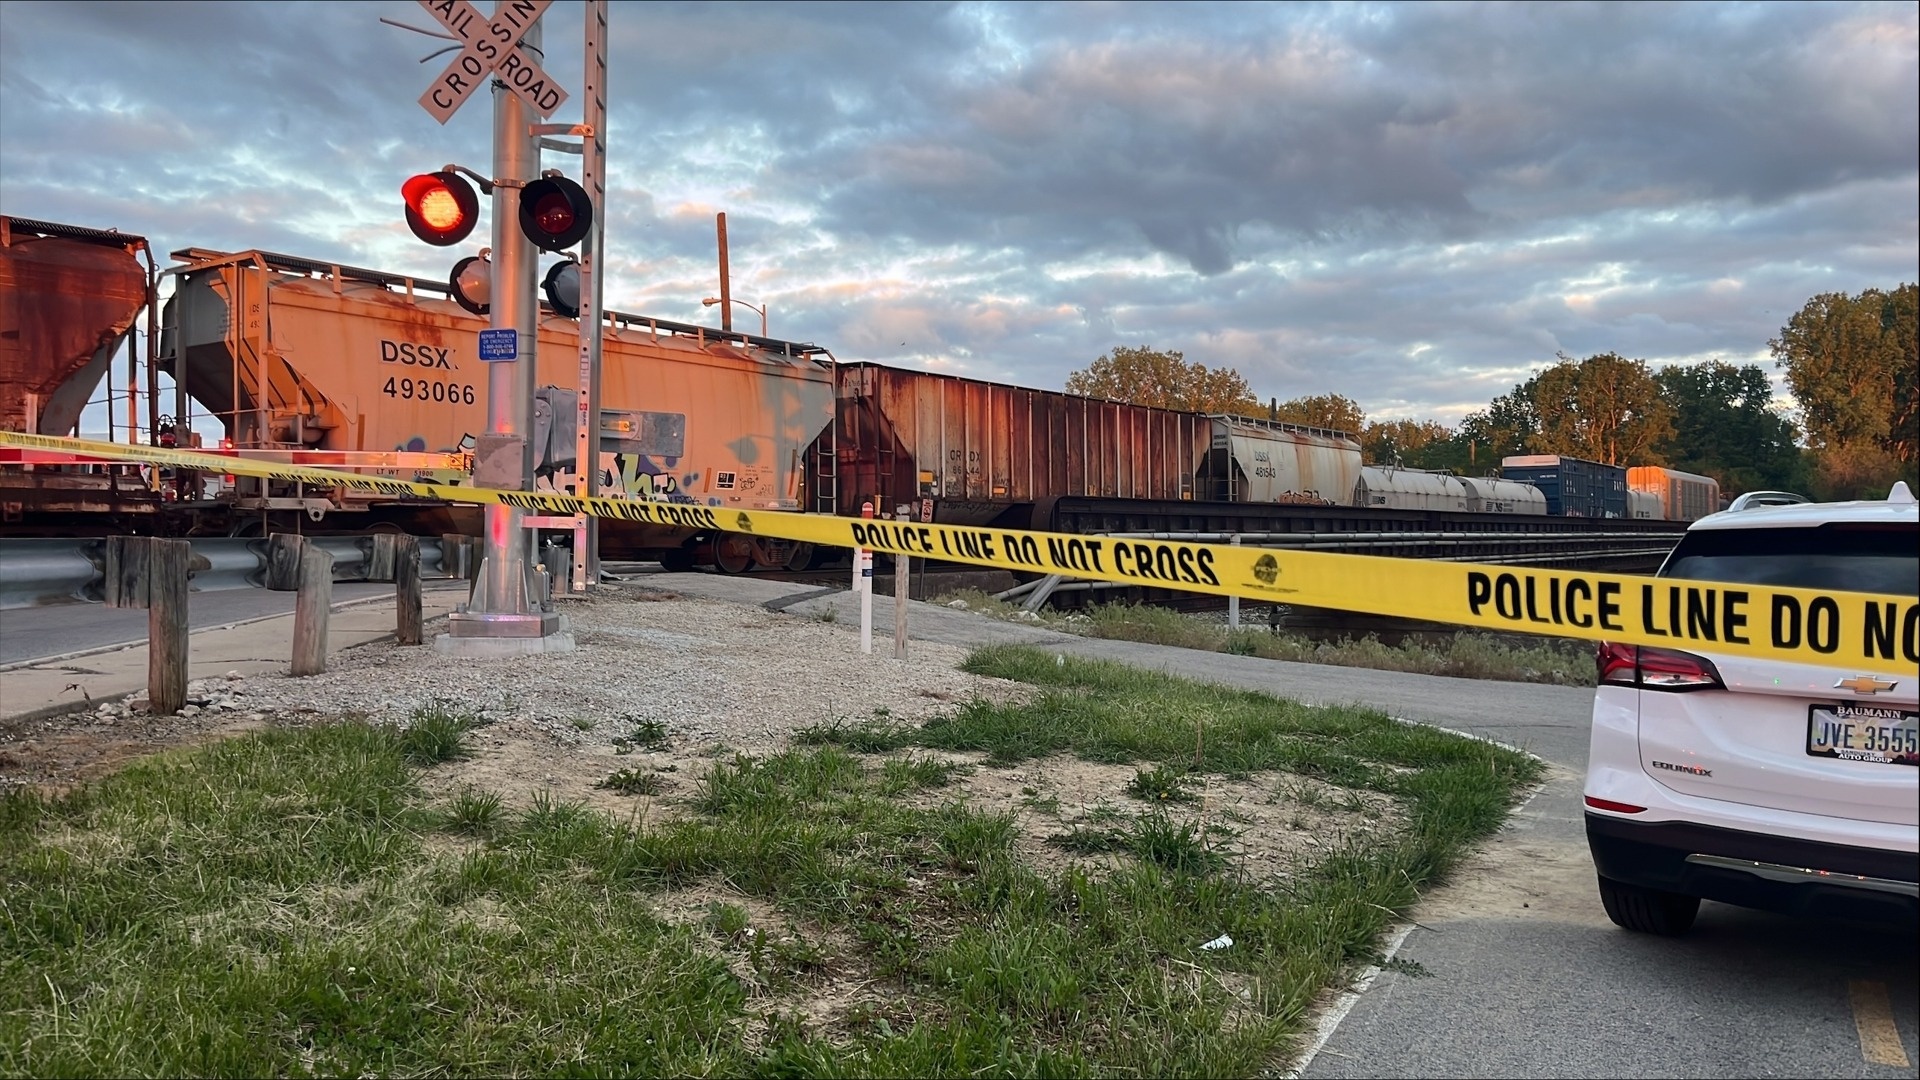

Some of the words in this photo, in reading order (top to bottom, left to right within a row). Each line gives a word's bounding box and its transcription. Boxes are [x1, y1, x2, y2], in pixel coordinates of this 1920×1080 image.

[429, 0, 474, 39] AIL
[500, 53, 560, 110] ROAD
[432, 0, 536, 109] CROSSIN
[381, 340, 451, 370] DSSX
[383, 377, 475, 405] 493066
[851, 523, 934, 553] POLICE
[939, 529, 995, 560] LINE
[1003, 534, 1043, 566] DO
[1047, 538, 1106, 574] NOT
[1113, 542, 1221, 587] CROSS
[1468, 571, 1624, 632] POLICE
[1641, 584, 1751, 645] LINE
[1770, 594, 1840, 654] DO
[1863, 601, 1919, 665] NO
[1837, 706, 1901, 719] BAUMANN
[1816, 722, 1856, 749] JVE
[1864, 726, 1918, 754] 3555
[1652, 761, 1713, 778] EQUINOX
[1838, 753, 1862, 761] AUTO
[1863, 755, 1893, 764] GROUP
